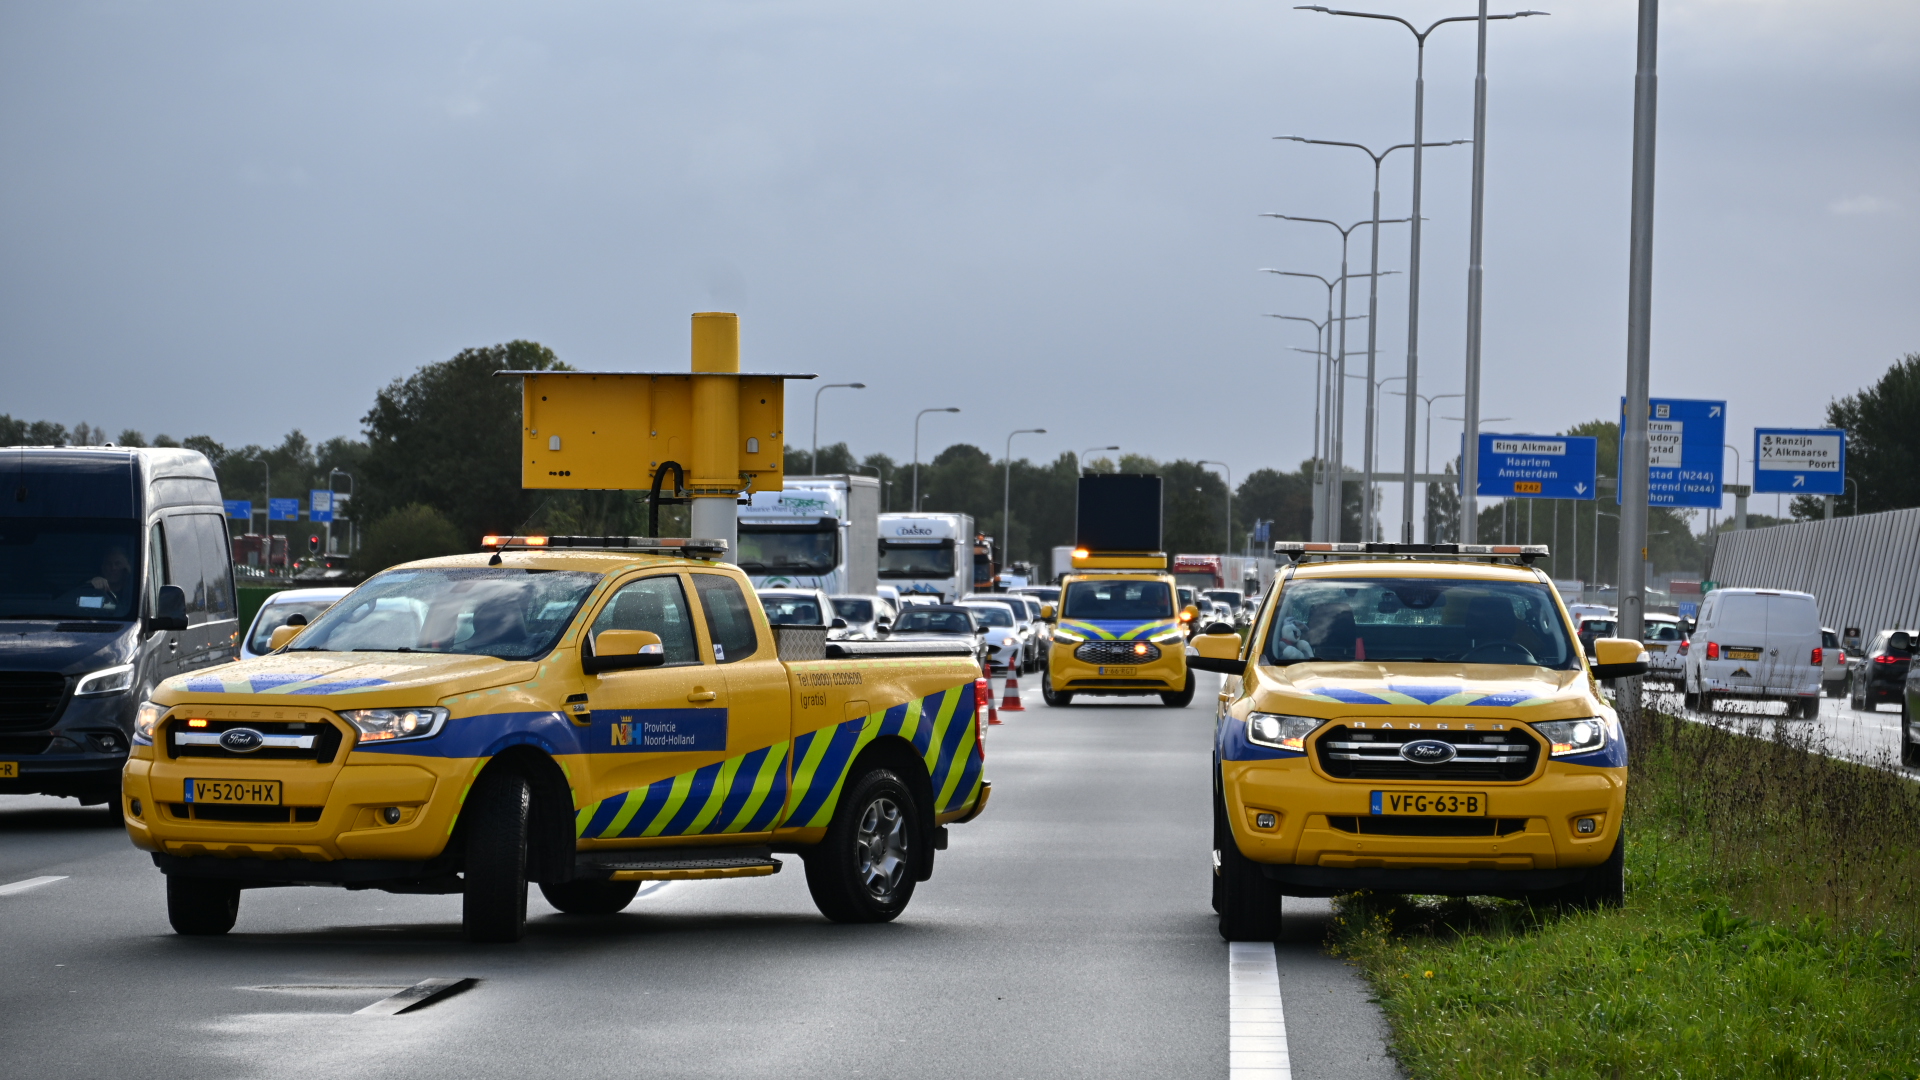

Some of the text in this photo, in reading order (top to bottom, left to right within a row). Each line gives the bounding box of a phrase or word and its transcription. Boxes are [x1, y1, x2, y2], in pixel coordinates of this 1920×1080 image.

[1649, 423, 1672, 431] trum
[1649, 433, 1679, 444] udorp
[1775, 436, 1813, 447] Ranzijn
[1496, 442, 1563, 453] Ring Alkmaar
[1649, 445, 1674, 453] rstad
[1775, 448, 1828, 457] Alkmaarse
[1507, 457, 1551, 467] Haarlem
[1808, 460, 1836, 469] Poort
[1499, 468, 1558, 478] Amsterdam
[1649, 470, 1714, 483] stad (N244)
[1649, 483, 1715, 493] erend (N244)
[1648, 494, 1674, 503] horn
[800, 692, 827, 709] (gratis)
[184, 709, 309, 719] RANGER
[644, 722, 676, 733] Provincie
[1353, 721, 1504, 731] RANGER
[227, 733, 251, 745] Ford
[644, 734, 695, 746] Noord-Holland
[1415, 745, 1442, 757] Ford
[196, 782, 274, 802] V-520-HX
[1389, 794, 1479, 814] VFG-63-B
